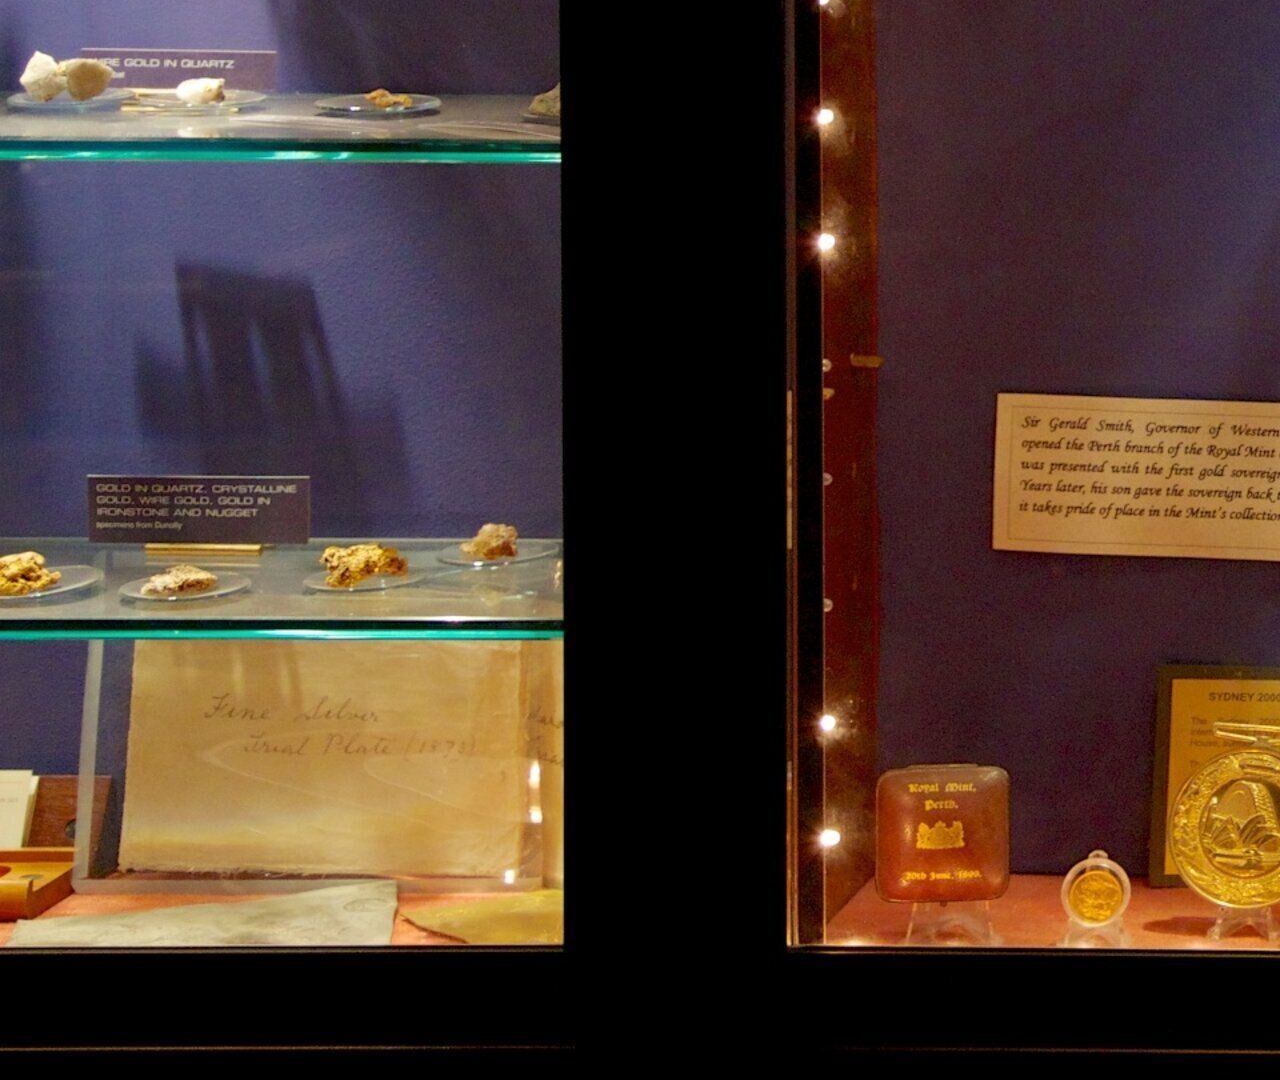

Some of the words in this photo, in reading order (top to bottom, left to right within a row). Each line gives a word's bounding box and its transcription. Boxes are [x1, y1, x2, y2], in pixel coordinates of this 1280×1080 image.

[123, 58, 161, 68] GOLD
[162, 58, 178, 68] IN
[179, 58, 235, 69] QUARTZ
[1021, 415, 1041, 429] Sir
[1048, 415, 1090, 434] Gerald
[1095, 417, 1134, 433] Smith,
[1144, 421, 1201, 438] Governor
[1207, 422, 1223, 439] of
[1230, 423, 1280, 437] Western
[1020, 436, 1063, 454] opened
[1064, 437, 1085, 451] the
[1086, 438, 1121, 453] Perth
[1123, 439, 1164, 454] branch
[1166, 441, 1181, 459] of
[1183, 442, 1203, 455] the
[1205, 443, 1243, 461] Royal
[1243, 445, 1276, 458] Mint
[1020, 460, 1045, 470] was
[1047, 458, 1107, 477] presented
[1110, 460, 1140, 474] with
[1144, 461, 1164, 475] the
[1164, 462, 1194, 480] first
[1197, 463, 1226, 481] gold
[95, 483, 131, 492] GOLD
[134, 484, 148, 492] IN
[210, 484, 297, 493] CRYSTALLINE
[1019, 478, 1053, 492] Years
[1054, 479, 1086, 495] later,
[1089, 480, 1108, 494] his
[1110, 486, 1131, 495] son
[1132, 486, 1162, 500] gave
[1165, 483, 1184, 497] the
[1187, 488, 1243, 503] sovereign
[1245, 486, 1276, 503] back
[138, 495, 170, 505] WIRE
[216, 496, 254, 505] GOLD
[256, 496, 271, 505] IN
[95, 507, 169, 517] IRONSTONE
[172, 507, 202, 517] AND
[204, 508, 259, 517] NUGGET
[1018, 501, 1029, 511] it
[1031, 499, 1063, 516] takes
[1064, 501, 1096, 519] pride
[1098, 502, 1114, 519] of
[1113, 502, 1145, 521] place
[1147, 505, 1161, 517] in
[1163, 504, 1182, 518] the
[1208, 691, 1255, 702] SYDNEY
